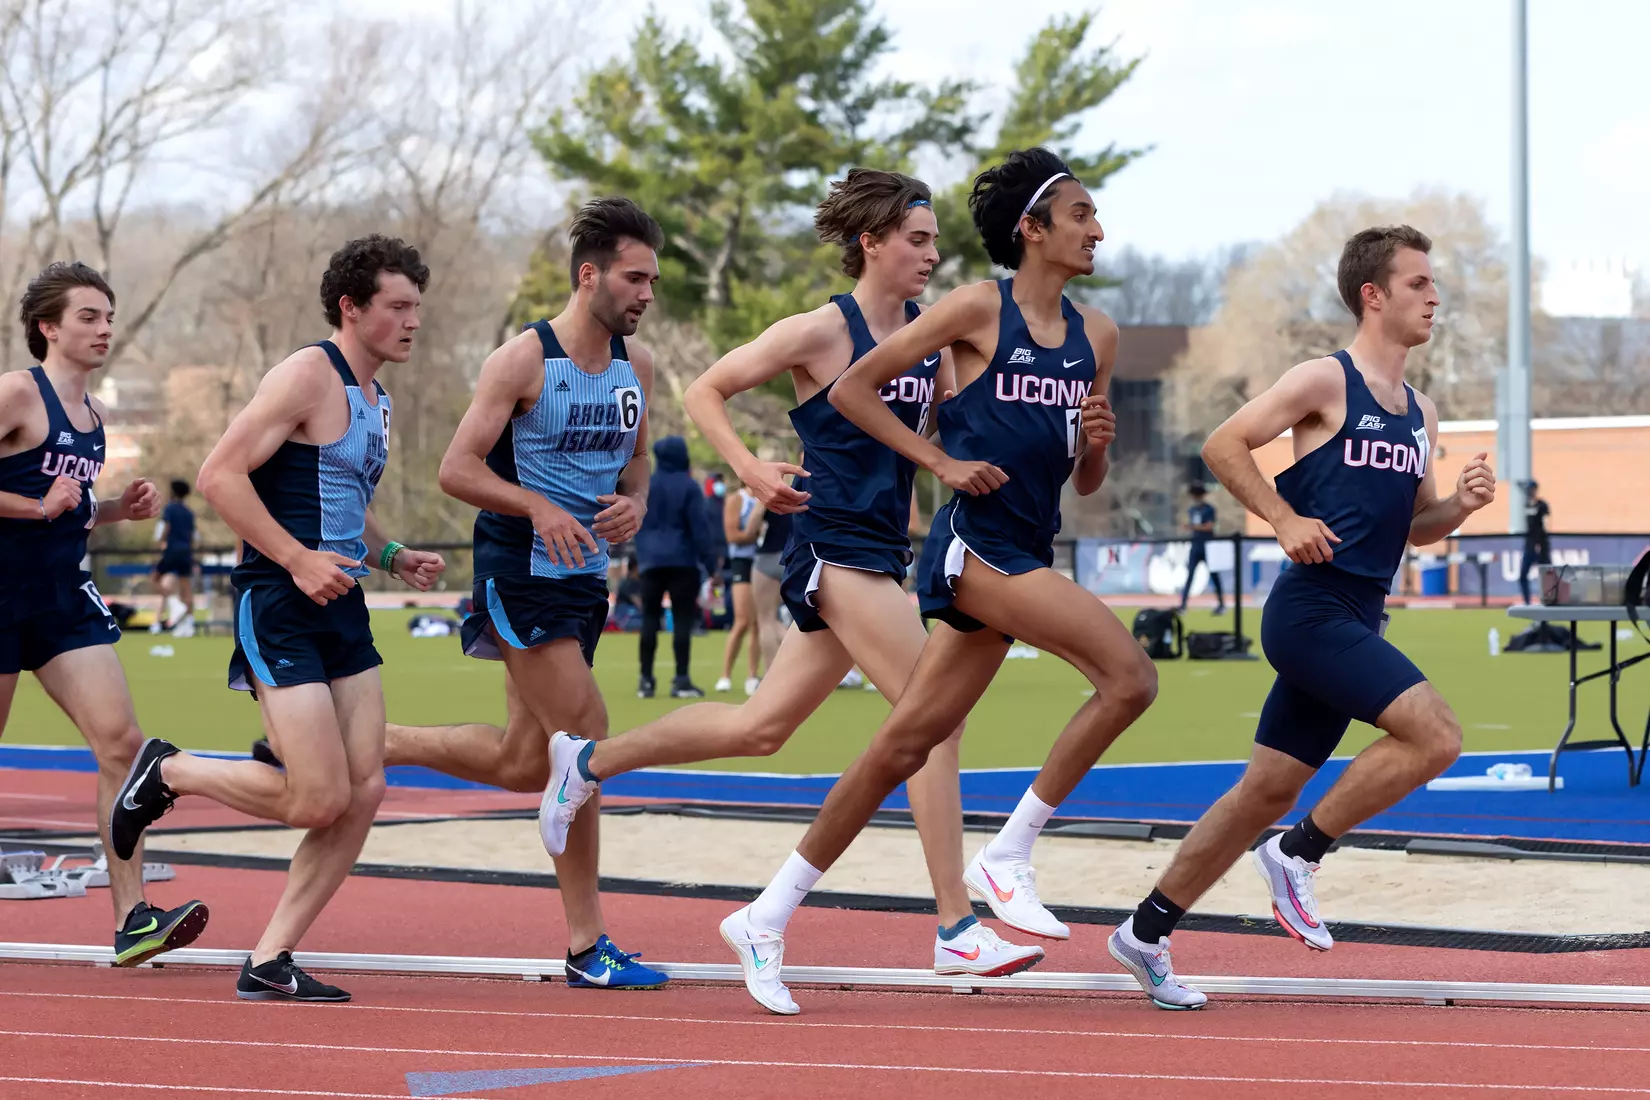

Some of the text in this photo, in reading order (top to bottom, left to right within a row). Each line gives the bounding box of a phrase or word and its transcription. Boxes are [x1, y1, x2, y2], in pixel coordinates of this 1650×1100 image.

[1010, 354, 1036, 363] EAST
[1014, 347, 1032, 356] BIG
[995, 372, 1092, 407] UCONN
[567, 403, 621, 427] RHOD
[621, 390, 638, 429] 6
[1361, 414, 1381, 423] BIG
[1357, 421, 1387, 430] EAST
[555, 430, 626, 451] ISLAND
[1344, 438, 1419, 474] UCON
